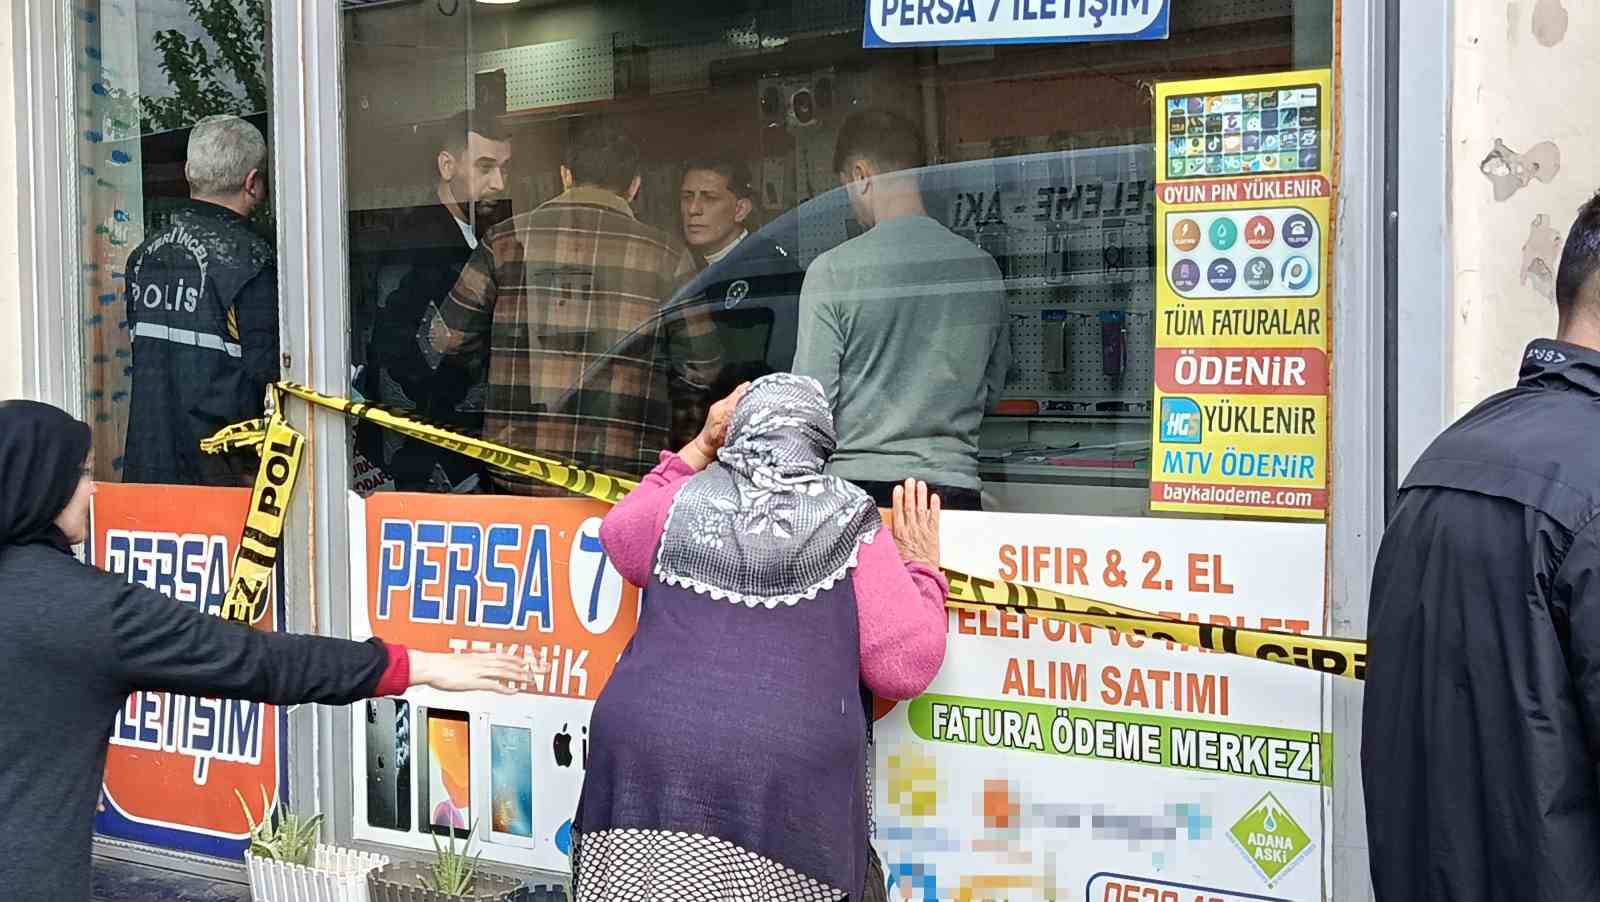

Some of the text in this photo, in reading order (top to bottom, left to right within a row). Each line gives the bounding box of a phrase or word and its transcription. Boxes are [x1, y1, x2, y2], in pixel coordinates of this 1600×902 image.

[881, 0, 976, 26] PERSA
[1164, 185, 1206, 204] OYUN
[1164, 304, 1321, 336] TÜM FATURALAR
[1167, 412, 1201, 437] HGS
[1163, 451, 1213, 475] MTV
[1163, 484, 1313, 507] baykalodeme.com
[377, 520, 609, 631] PERSA 7
[998, 544, 1088, 586] SIFIR
[1102, 548, 1127, 588] &
[1141, 550, 1174, 592] 2.
[1187, 552, 1235, 594] EL
[946, 604, 1093, 646] ELEFON
[1002, 657, 1230, 717] ALIM SATIMI
[932, 703, 1321, 783] FATURA ÖDEME MERKEZİ
[1247, 832, 1294, 850] ADANA
